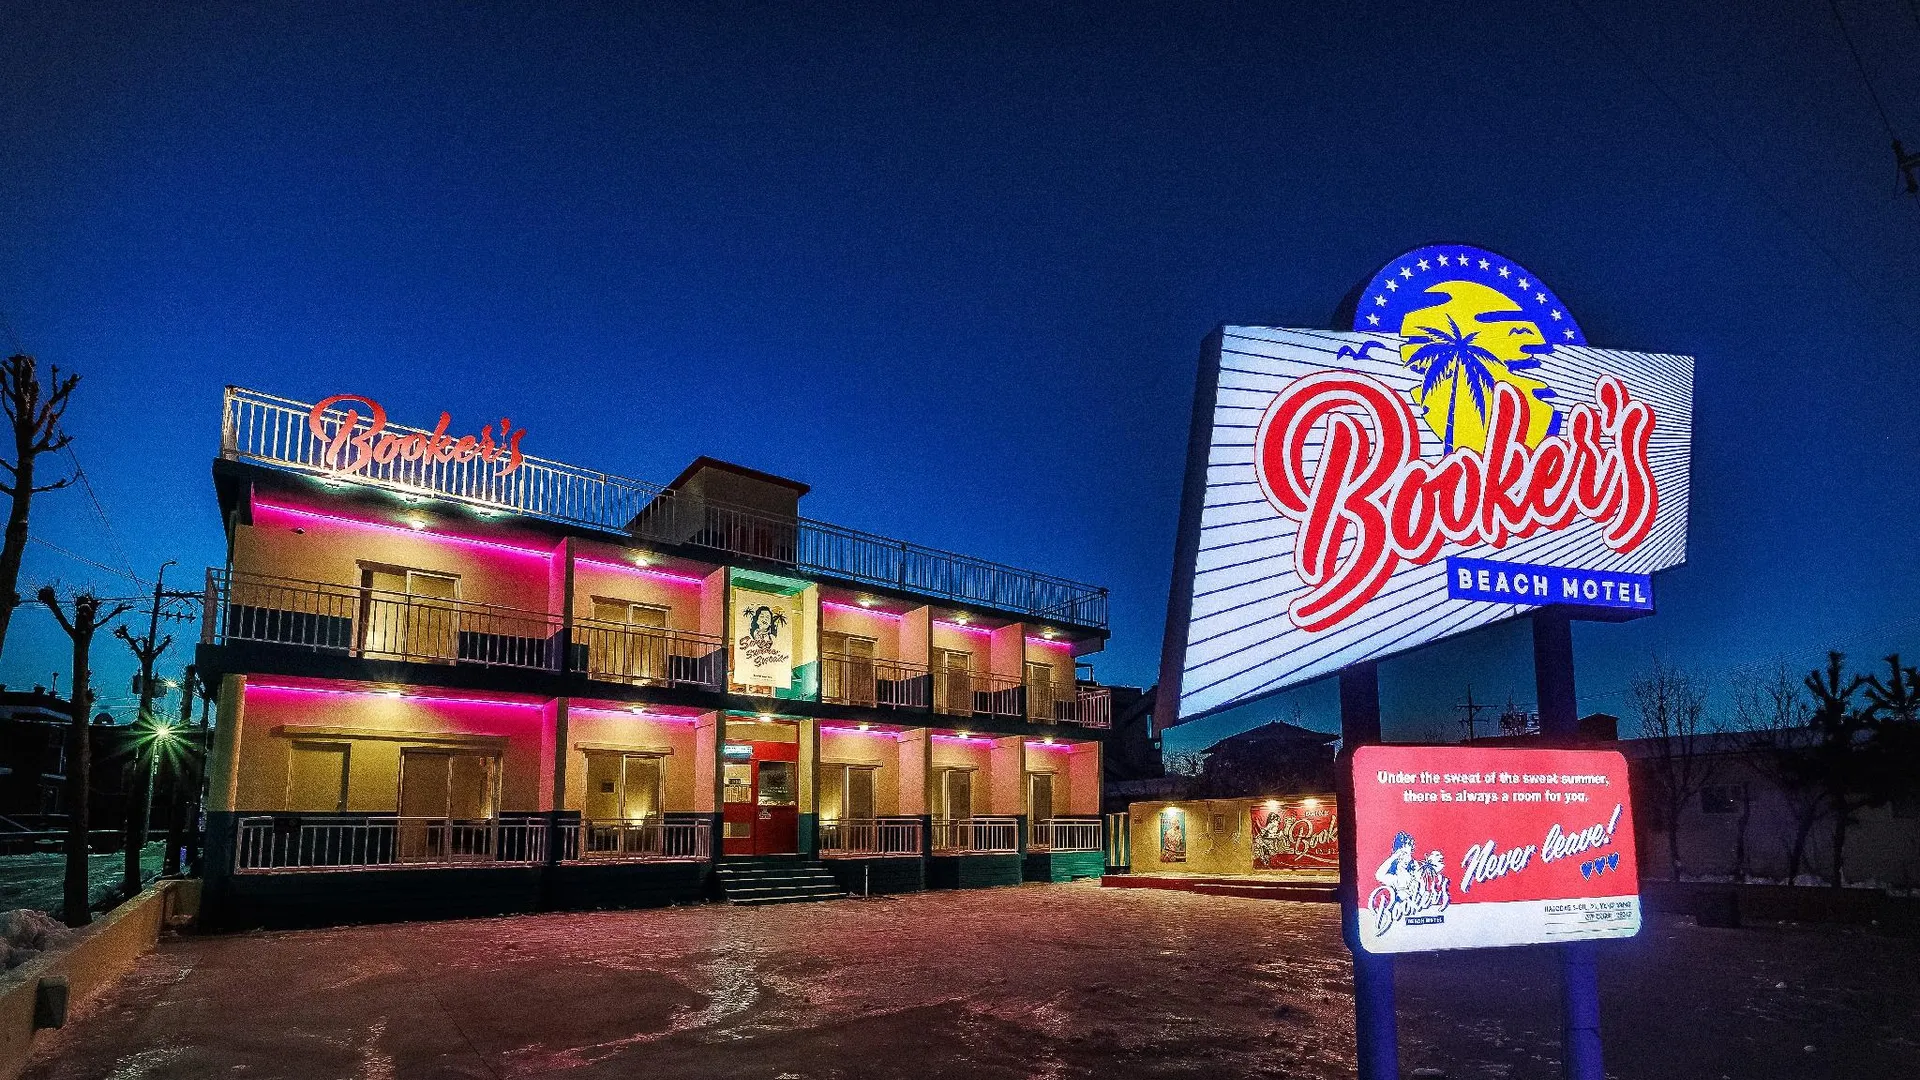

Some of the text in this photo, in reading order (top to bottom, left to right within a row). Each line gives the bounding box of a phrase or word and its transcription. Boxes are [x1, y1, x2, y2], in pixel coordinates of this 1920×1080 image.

[309, 394, 527, 476] Booker's
[1255, 369, 1658, 632] Booker's
[1458, 568, 1646, 603] BEACH MOTEL
[1377, 770, 1417, 784] Under
[1420, 771, 1440, 784] the
[1443, 772, 1481, 784] sweat
[1484, 771, 1497, 784] of
[1499, 771, 1520, 784] the
[1561, 774, 1610, 787] summer,
[1403, 789, 1589, 805] there is always a room for you.
[1459, 803, 1623, 893] Never leave!
